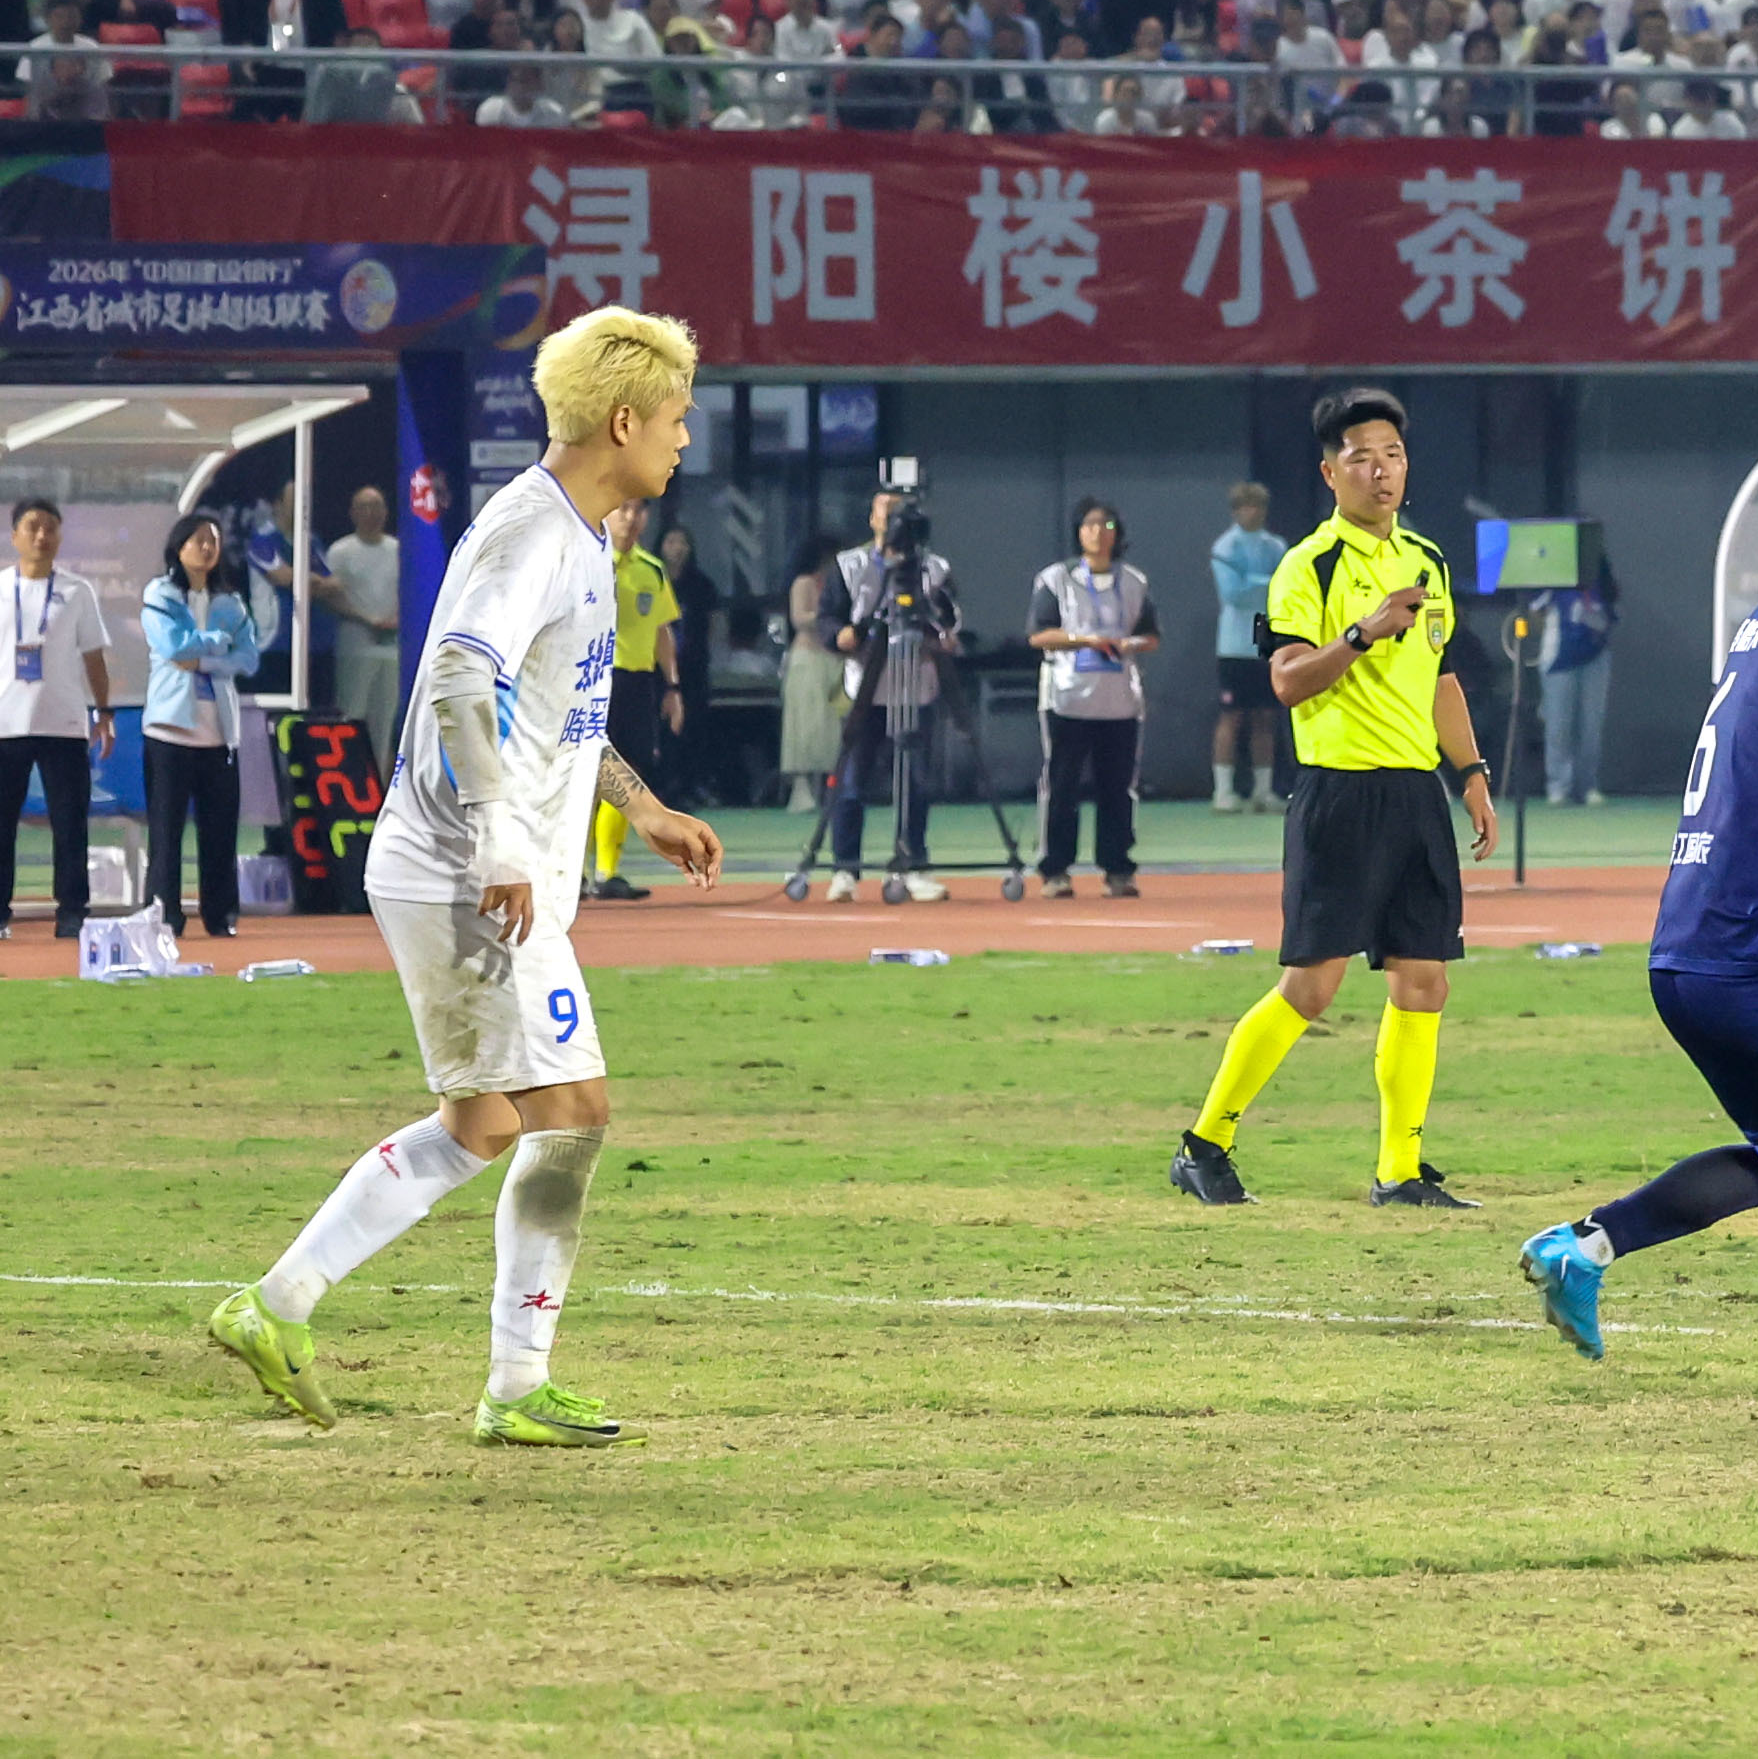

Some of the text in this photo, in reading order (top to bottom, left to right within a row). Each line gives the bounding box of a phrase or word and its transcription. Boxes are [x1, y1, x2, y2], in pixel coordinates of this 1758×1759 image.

[523, 164, 1738, 329] 浔阳楼小茶饼
[1683, 672, 1737, 817] 6
[547, 987, 579, 1044] 9
